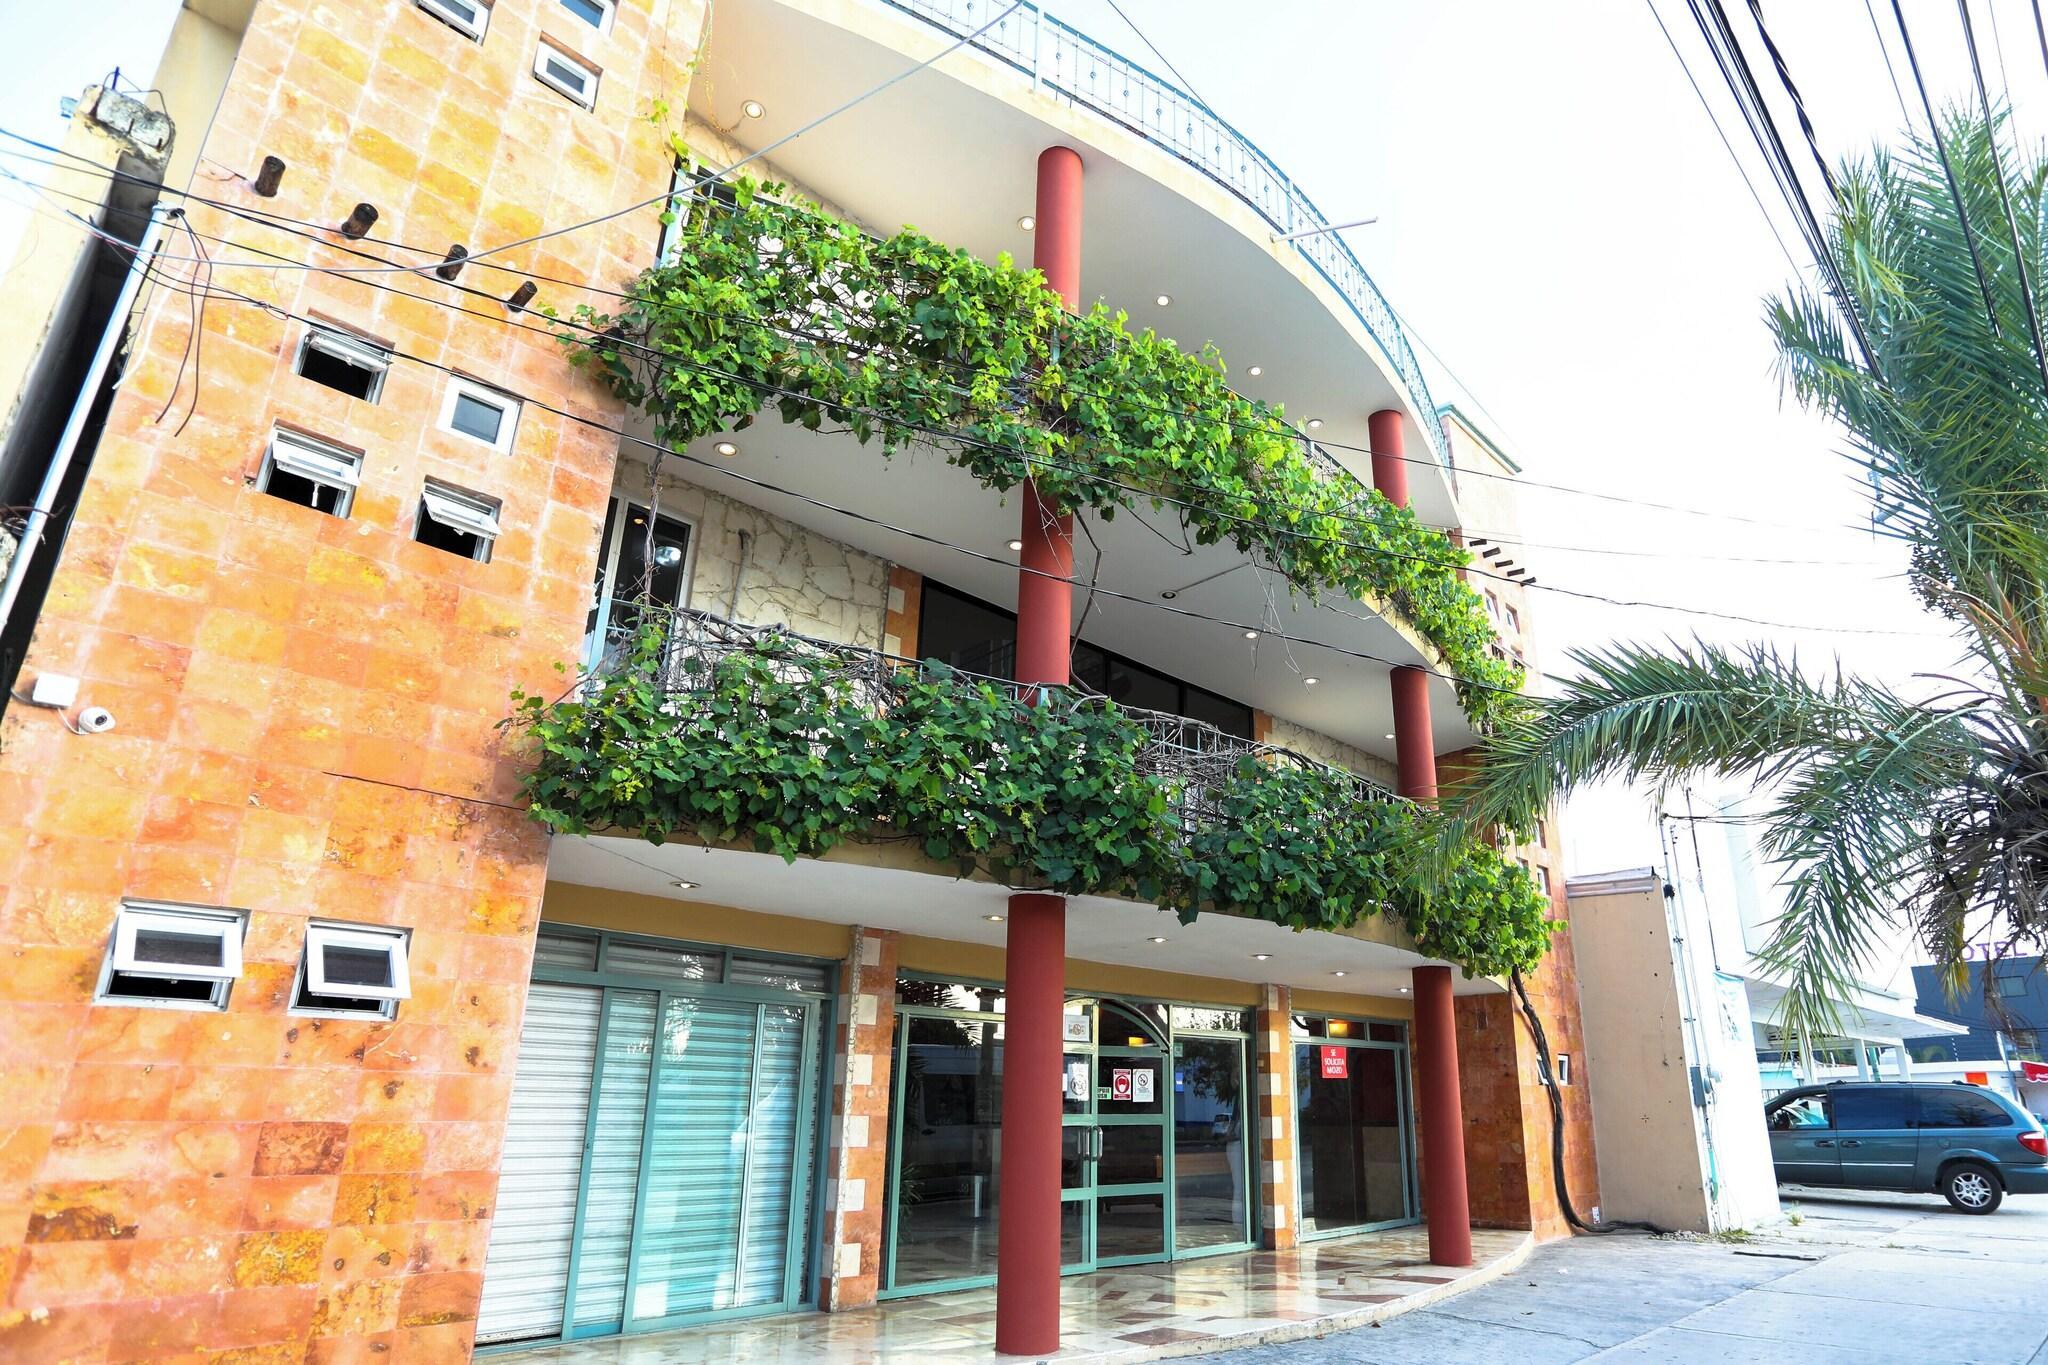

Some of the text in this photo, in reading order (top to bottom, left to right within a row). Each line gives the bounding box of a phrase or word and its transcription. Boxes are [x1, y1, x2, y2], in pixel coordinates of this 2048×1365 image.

[1936, 941, 2028, 962] OTEL
[1324, 1057, 1344, 1066] SOLICITA
[1326, 1066, 1343, 1074] MOZO
